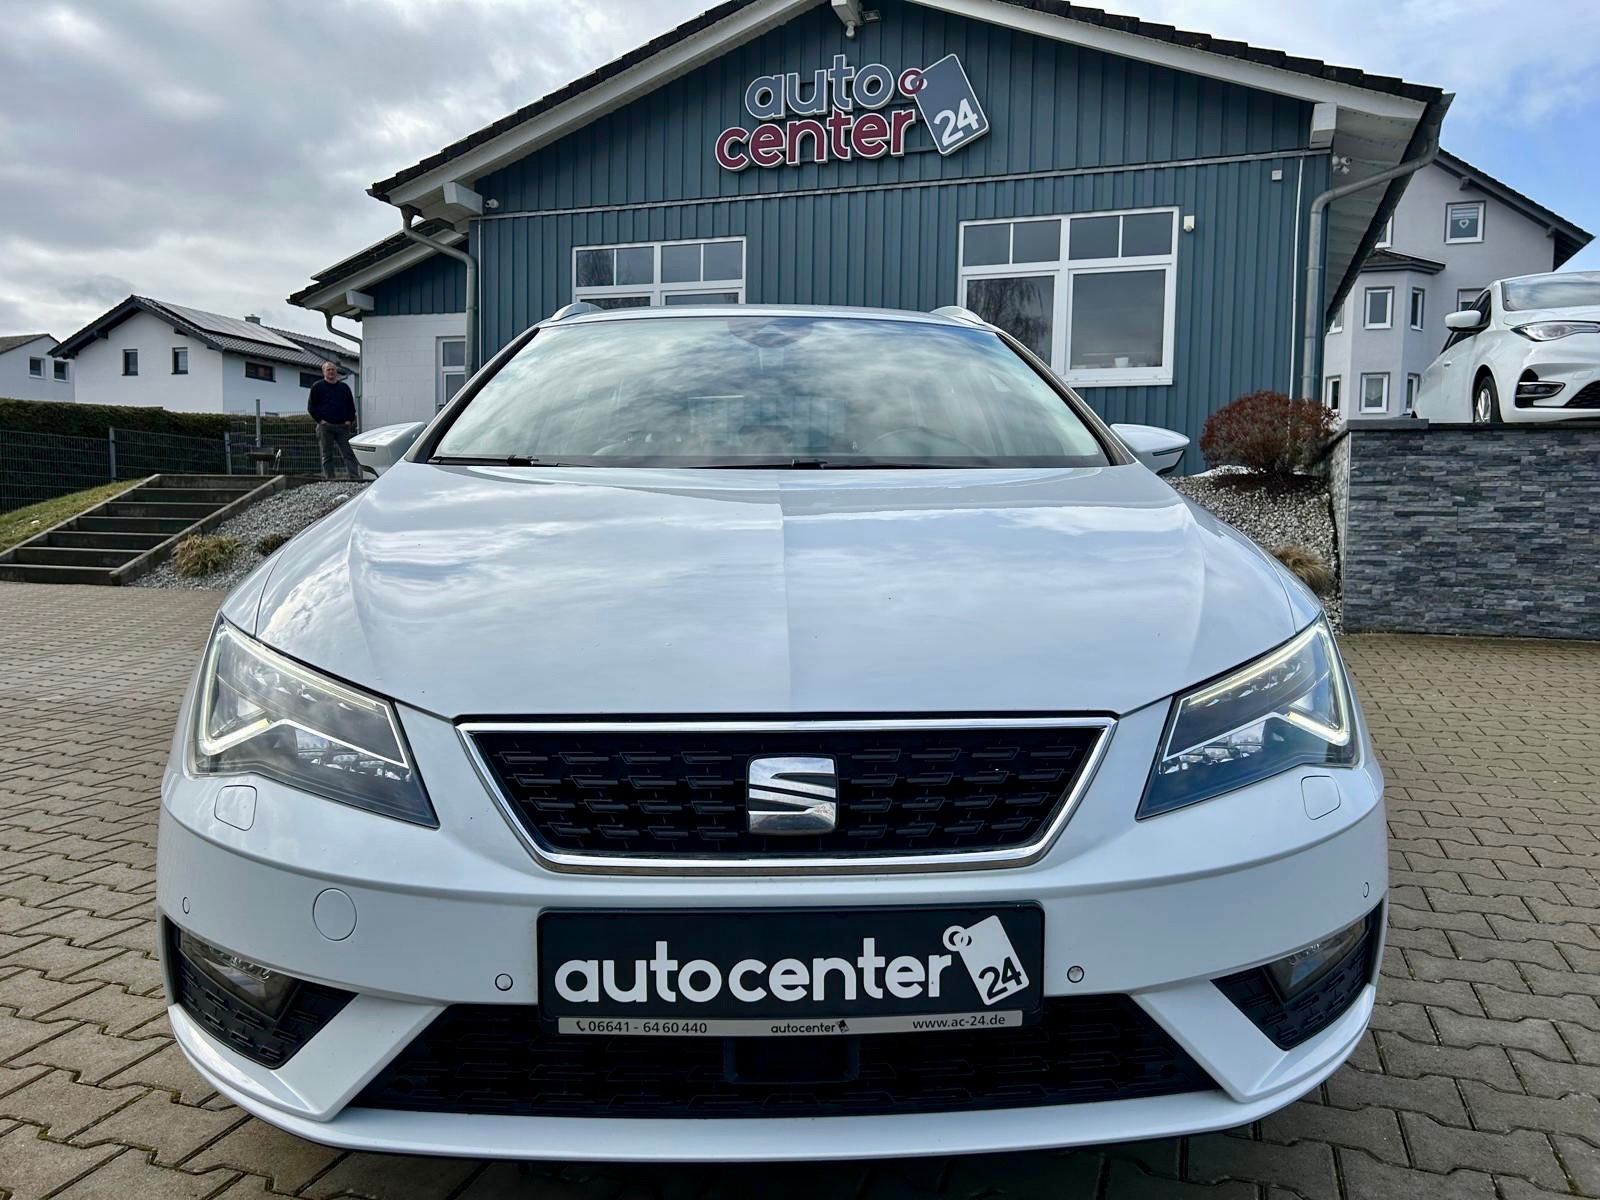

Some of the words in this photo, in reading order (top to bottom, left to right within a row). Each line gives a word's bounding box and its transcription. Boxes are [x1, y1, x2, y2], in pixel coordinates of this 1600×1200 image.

[745, 54, 895, 120] auto
[715, 105, 915, 171] center
[933, 97, 979, 147] 24
[555, 937, 952, 1003] autocenter
[978, 956, 1023, 1000] 24
[588, 1020, 630, 1032] 06641
[770, 1022, 835, 1033] autocenter
[912, 1014, 1006, 1029] www.ac-24.de
